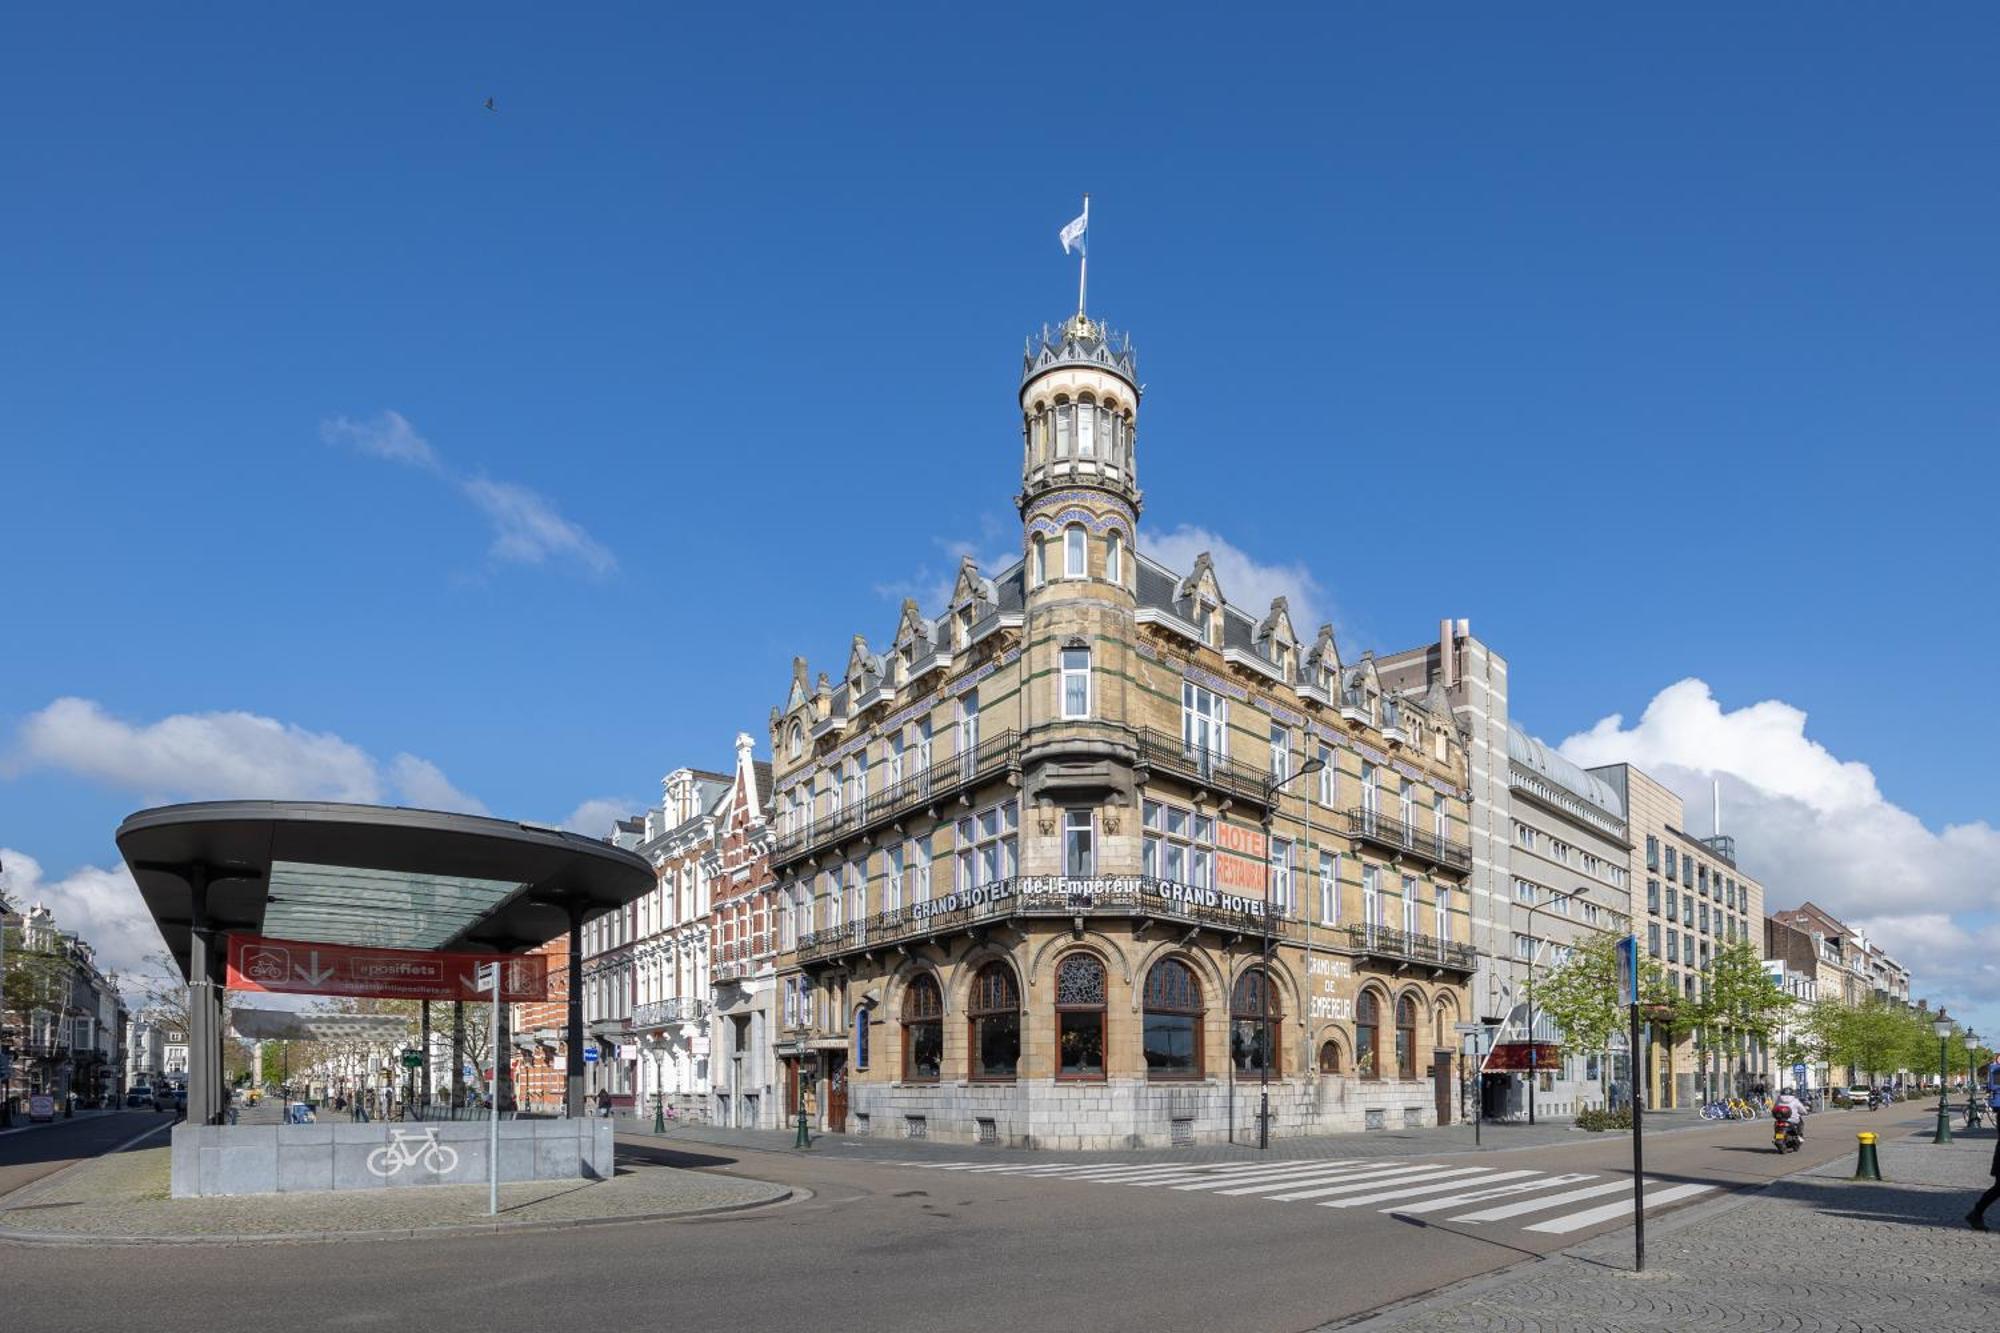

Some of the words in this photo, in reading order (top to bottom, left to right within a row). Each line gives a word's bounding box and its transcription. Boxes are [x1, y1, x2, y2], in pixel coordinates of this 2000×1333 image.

[913, 895, 957, 919] GRAND
[961, 880, 1008, 908] HOTEL
[1160, 881, 1215, 907] GRAND
[1222, 895, 1265, 916] HOTEL
[1331, 960, 1351, 979] HOTEL
[1324, 979, 1336, 993] DE
